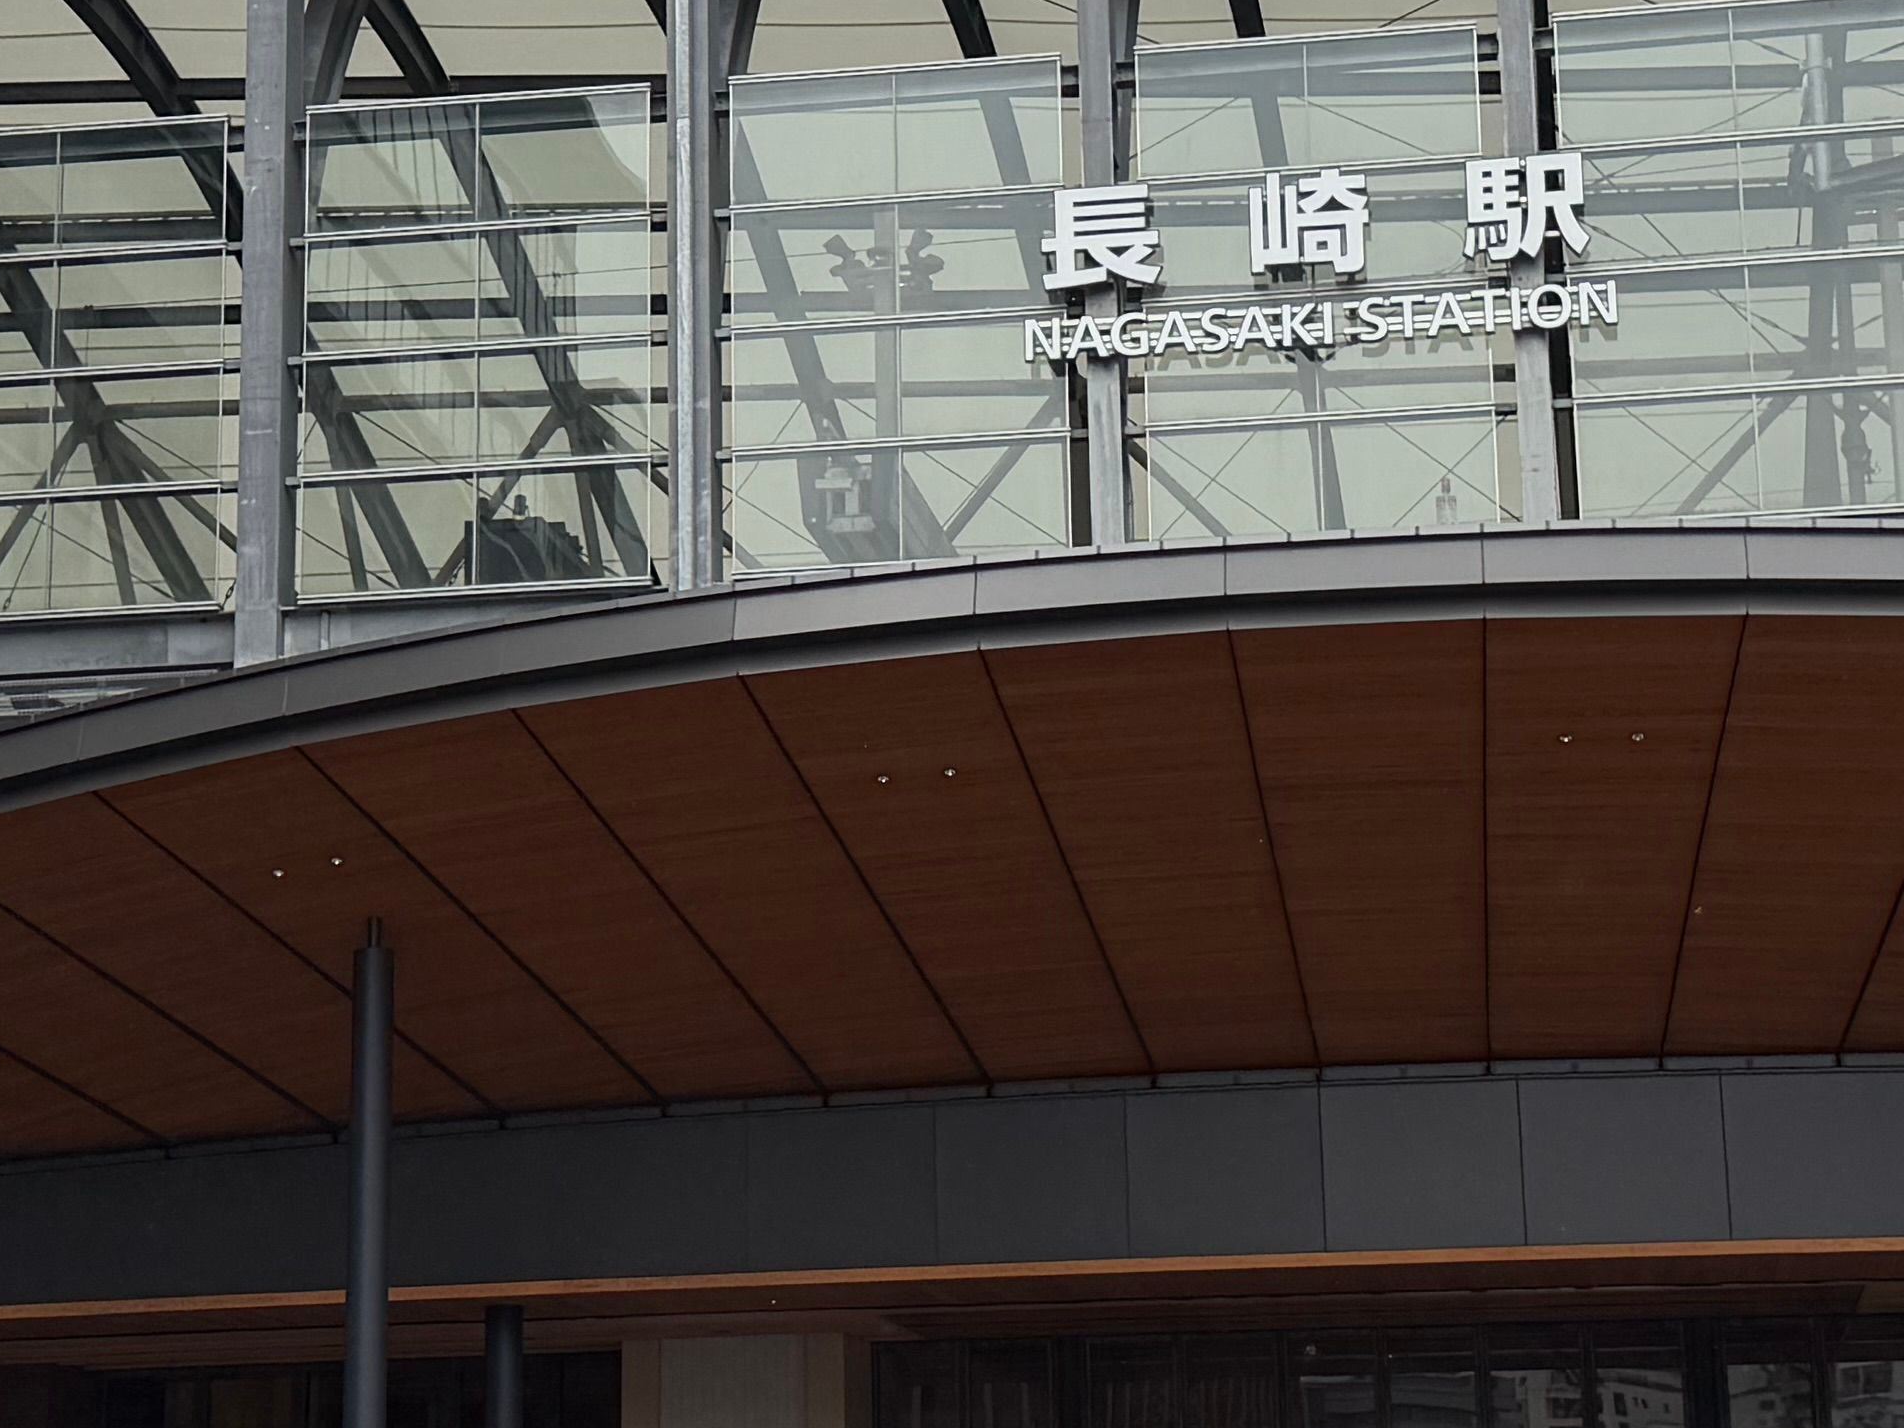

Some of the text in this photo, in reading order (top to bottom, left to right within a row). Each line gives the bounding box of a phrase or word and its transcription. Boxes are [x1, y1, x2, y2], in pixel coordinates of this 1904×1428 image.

[1040, 152, 1590, 290] 長崎駅
[1022, 278, 1619, 362] NAGASAKI STATION
